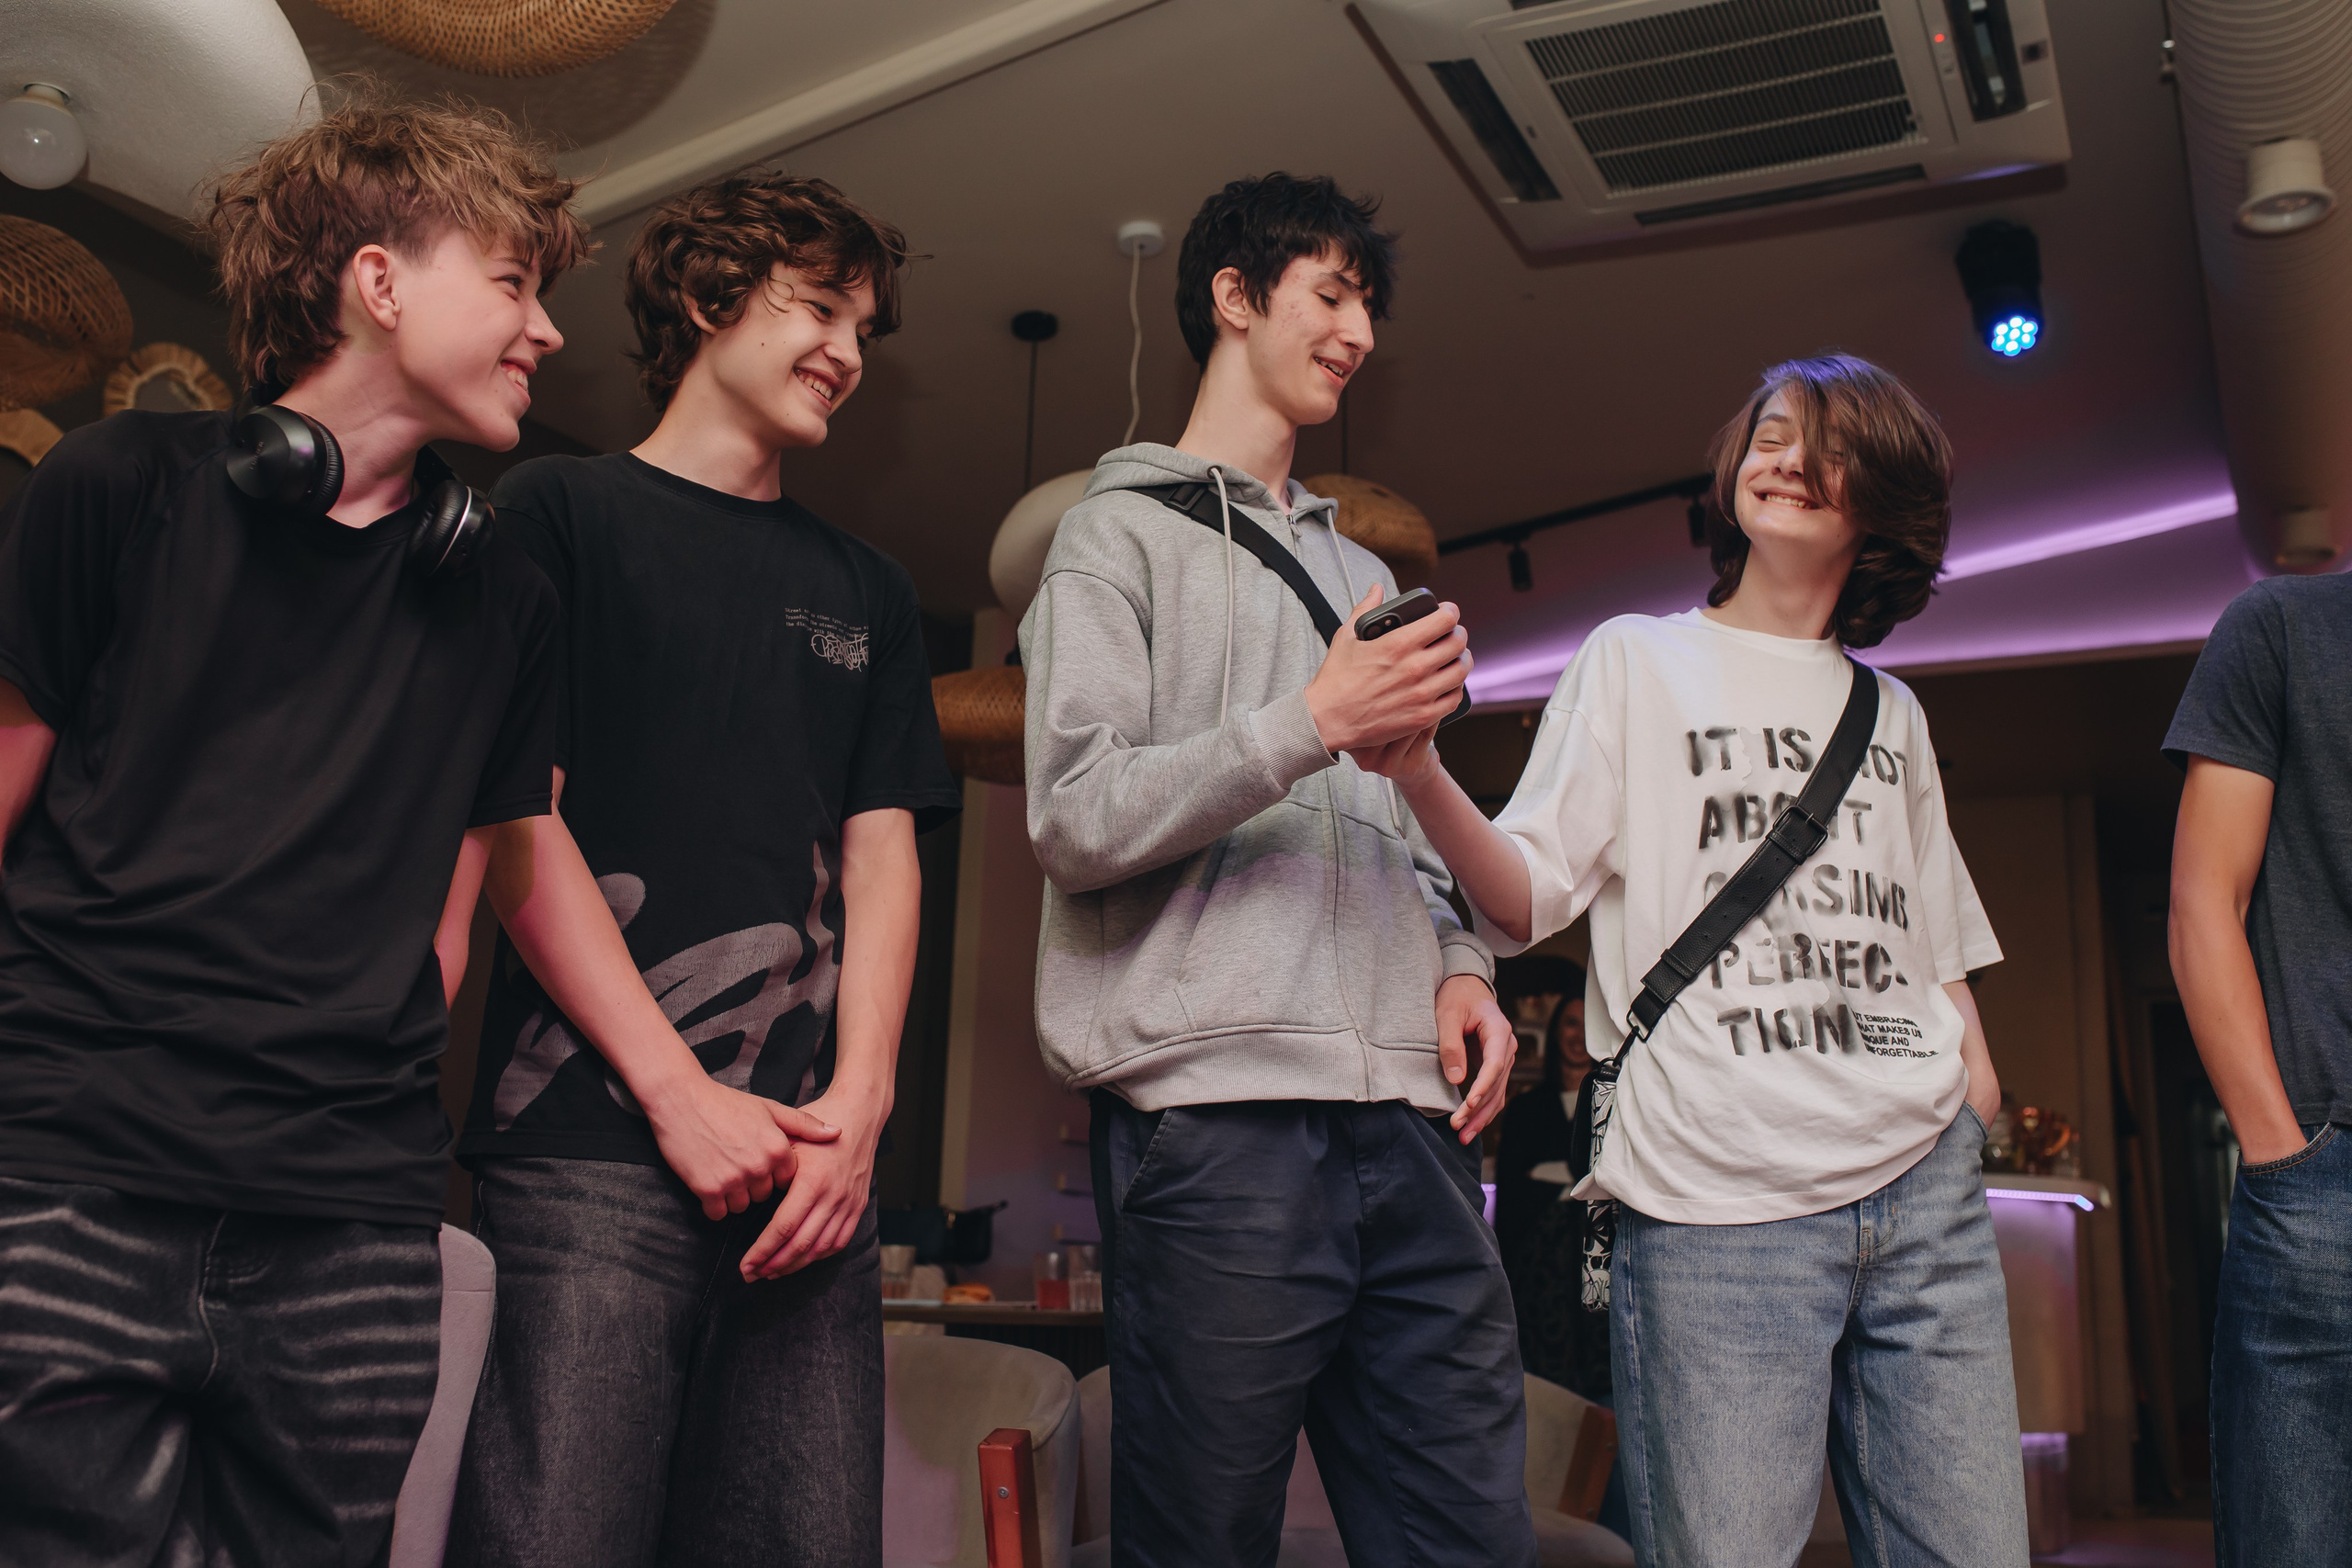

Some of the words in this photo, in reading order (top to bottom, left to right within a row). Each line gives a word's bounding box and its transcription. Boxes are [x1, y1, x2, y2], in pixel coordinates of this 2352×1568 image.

[1686, 728, 1737, 776] IT
[1762, 728, 1815, 772] IS
[1859, 743, 1908, 794] OT
[1699, 791, 1871, 850] ABT
[1717, 1004, 1851, 1056] TION
[1851, 1009, 1863, 1021] UT
[1877, 1025, 1910, 1035] MAKES
[1892, 1036, 1909, 1046] AND
